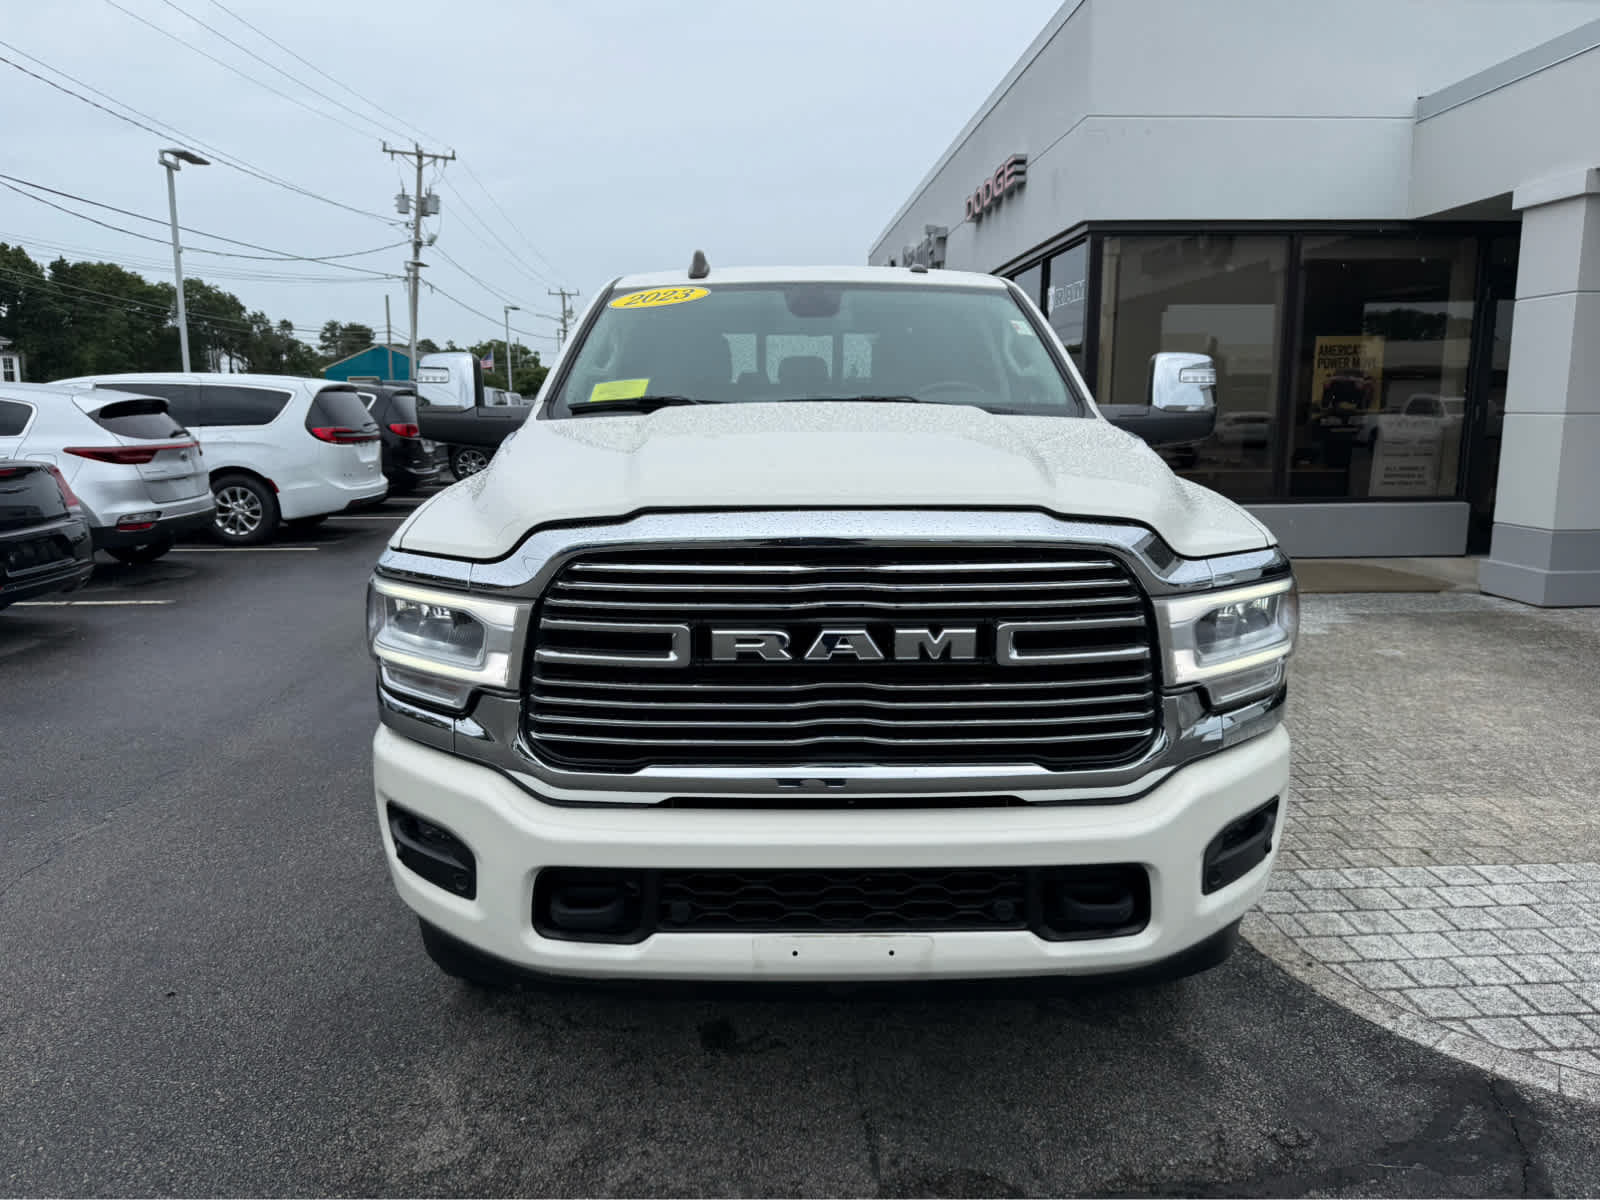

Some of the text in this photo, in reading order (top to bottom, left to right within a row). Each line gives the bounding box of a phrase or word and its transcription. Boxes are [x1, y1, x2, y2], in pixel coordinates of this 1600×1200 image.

[966, 154, 1027, 221] DODGE
[624, 289, 694, 305] 2023
[1317, 357, 1350, 369] POWER
[711, 628, 976, 661] RAM
